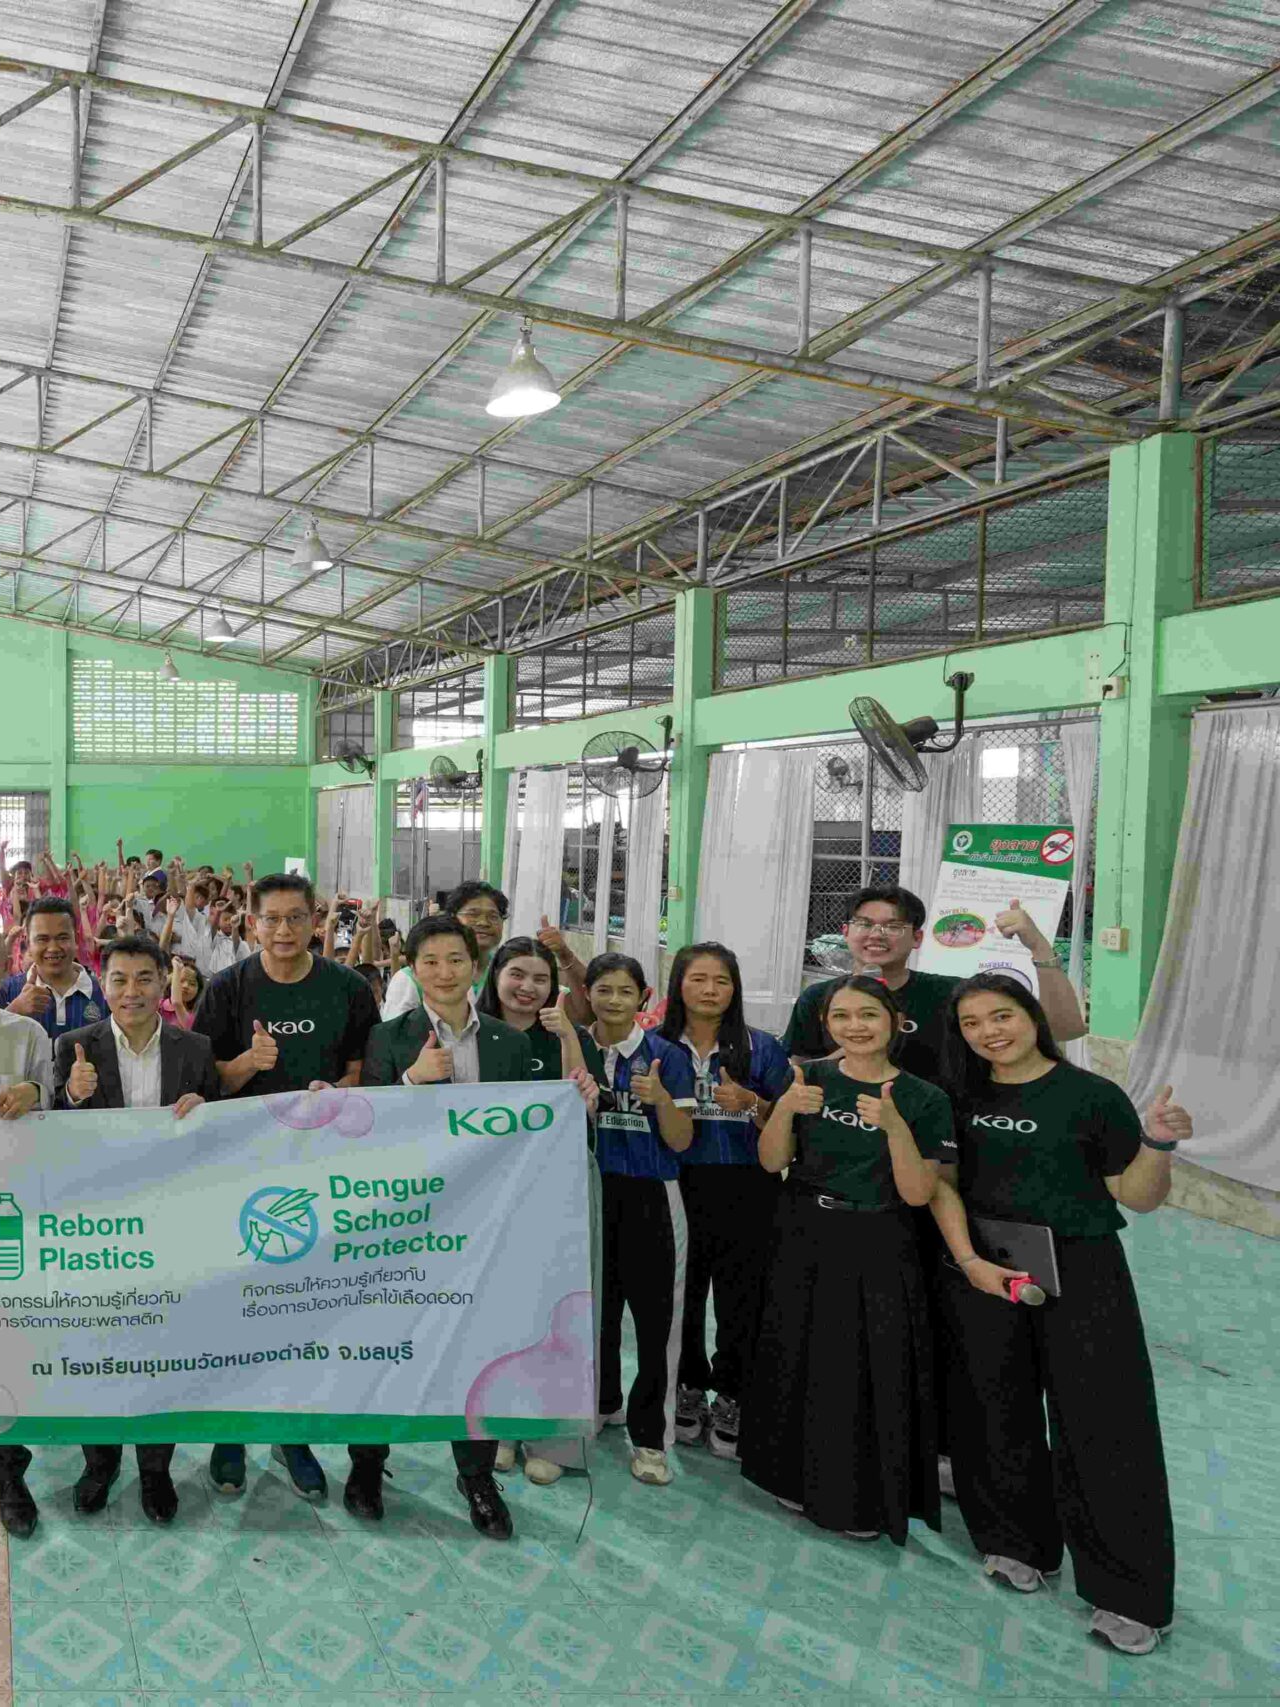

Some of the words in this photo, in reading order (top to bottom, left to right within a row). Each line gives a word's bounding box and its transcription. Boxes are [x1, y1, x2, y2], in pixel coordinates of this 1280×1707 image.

[606, 1115, 644, 1129] Education
[329, 1174, 445, 1202] Dengue
[38, 1213, 145, 1237] Reborn
[332, 1202, 431, 1235] School
[39, 1246, 155, 1272] Plastics
[333, 1230, 468, 1262] Protector
[242, 1267, 426, 1298] กิจกรรมให้ความรู้เกี่ยวกับ
[242, 1288, 473, 1319] เรื่องการป้องกันโรคไข้เลือดออก
[32, 1362, 53, 1376] ณ
[61, 1340, 330, 1378] โรงเรียนชุมชนวัดหนองตำลึง
[339, 1339, 414, 1365] จ.ชลบุรี
